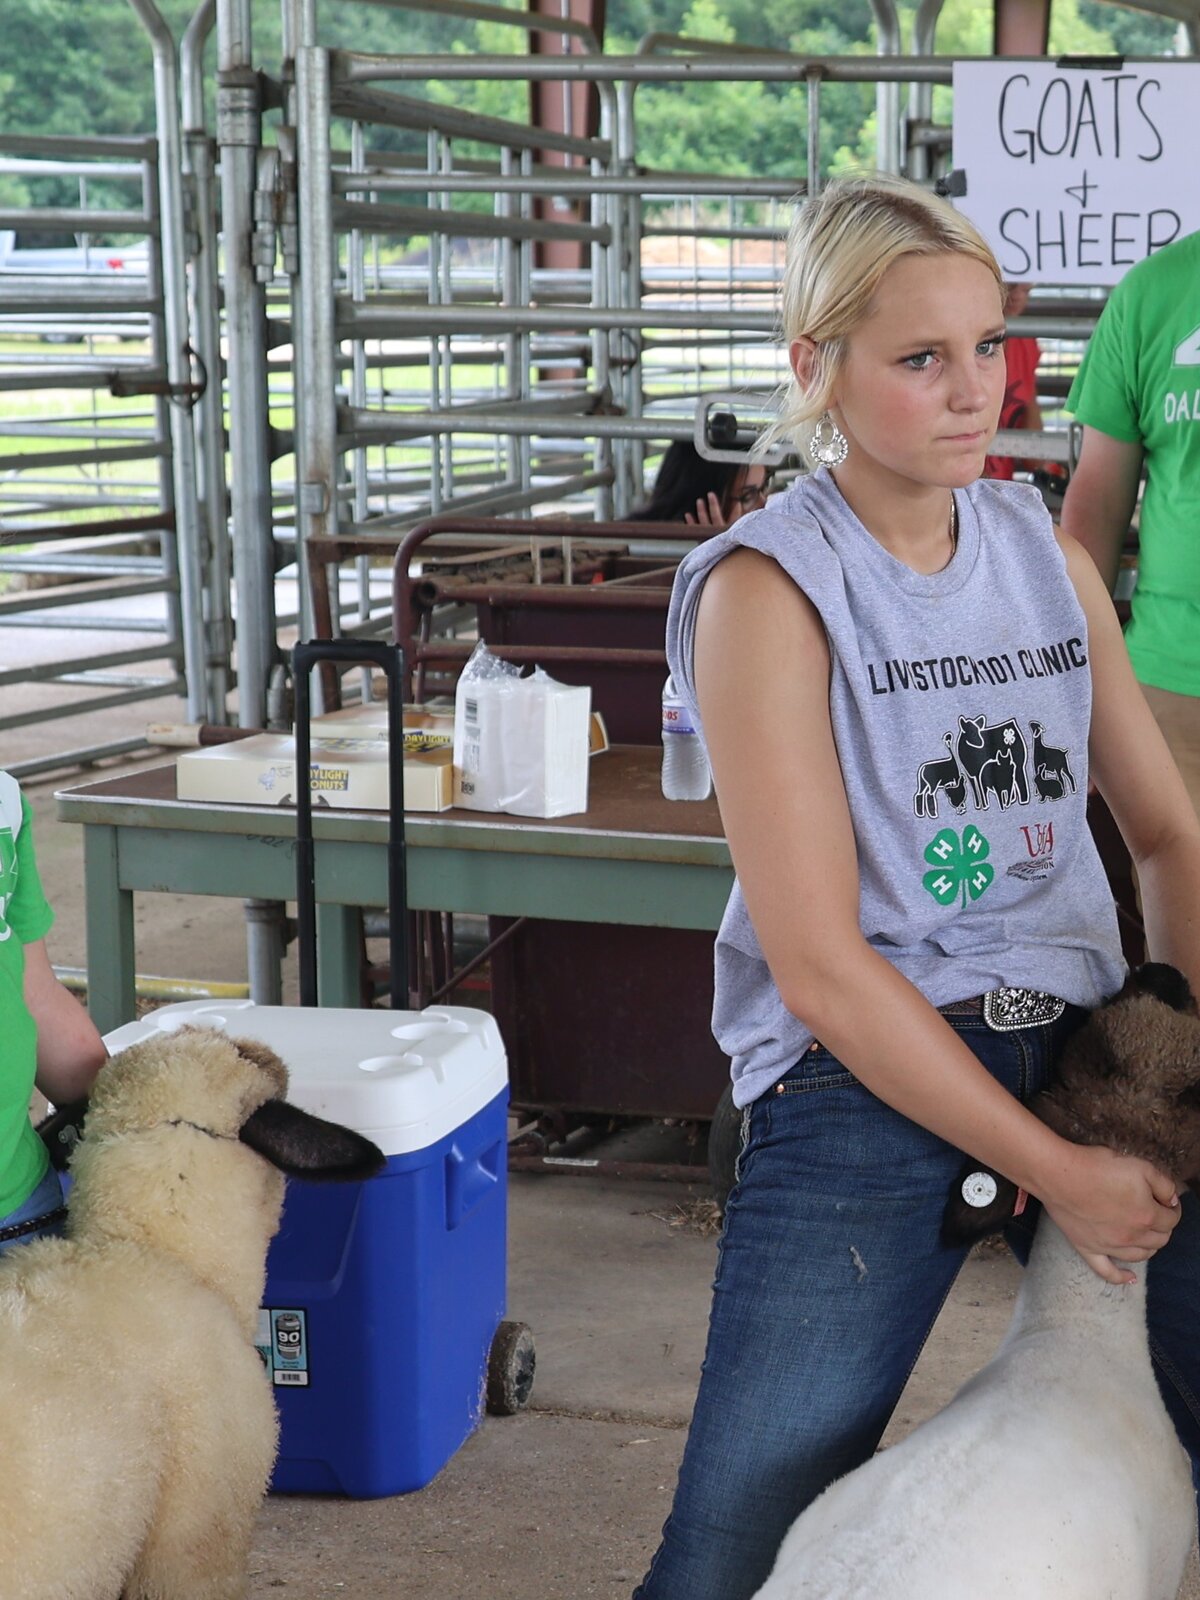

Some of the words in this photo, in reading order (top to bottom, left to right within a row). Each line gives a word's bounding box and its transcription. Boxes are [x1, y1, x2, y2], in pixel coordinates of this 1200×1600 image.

[998, 74, 1163, 164] GOATS
[999, 208, 1181, 275] SHEEP
[1018, 637, 1087, 678] CLINIC
[404, 734, 450, 743] DAYLIGHT
[310, 769, 347, 780] YLIGHT
[310, 779, 345, 790] ONUTS
[278, 1331, 300, 1343] 90
